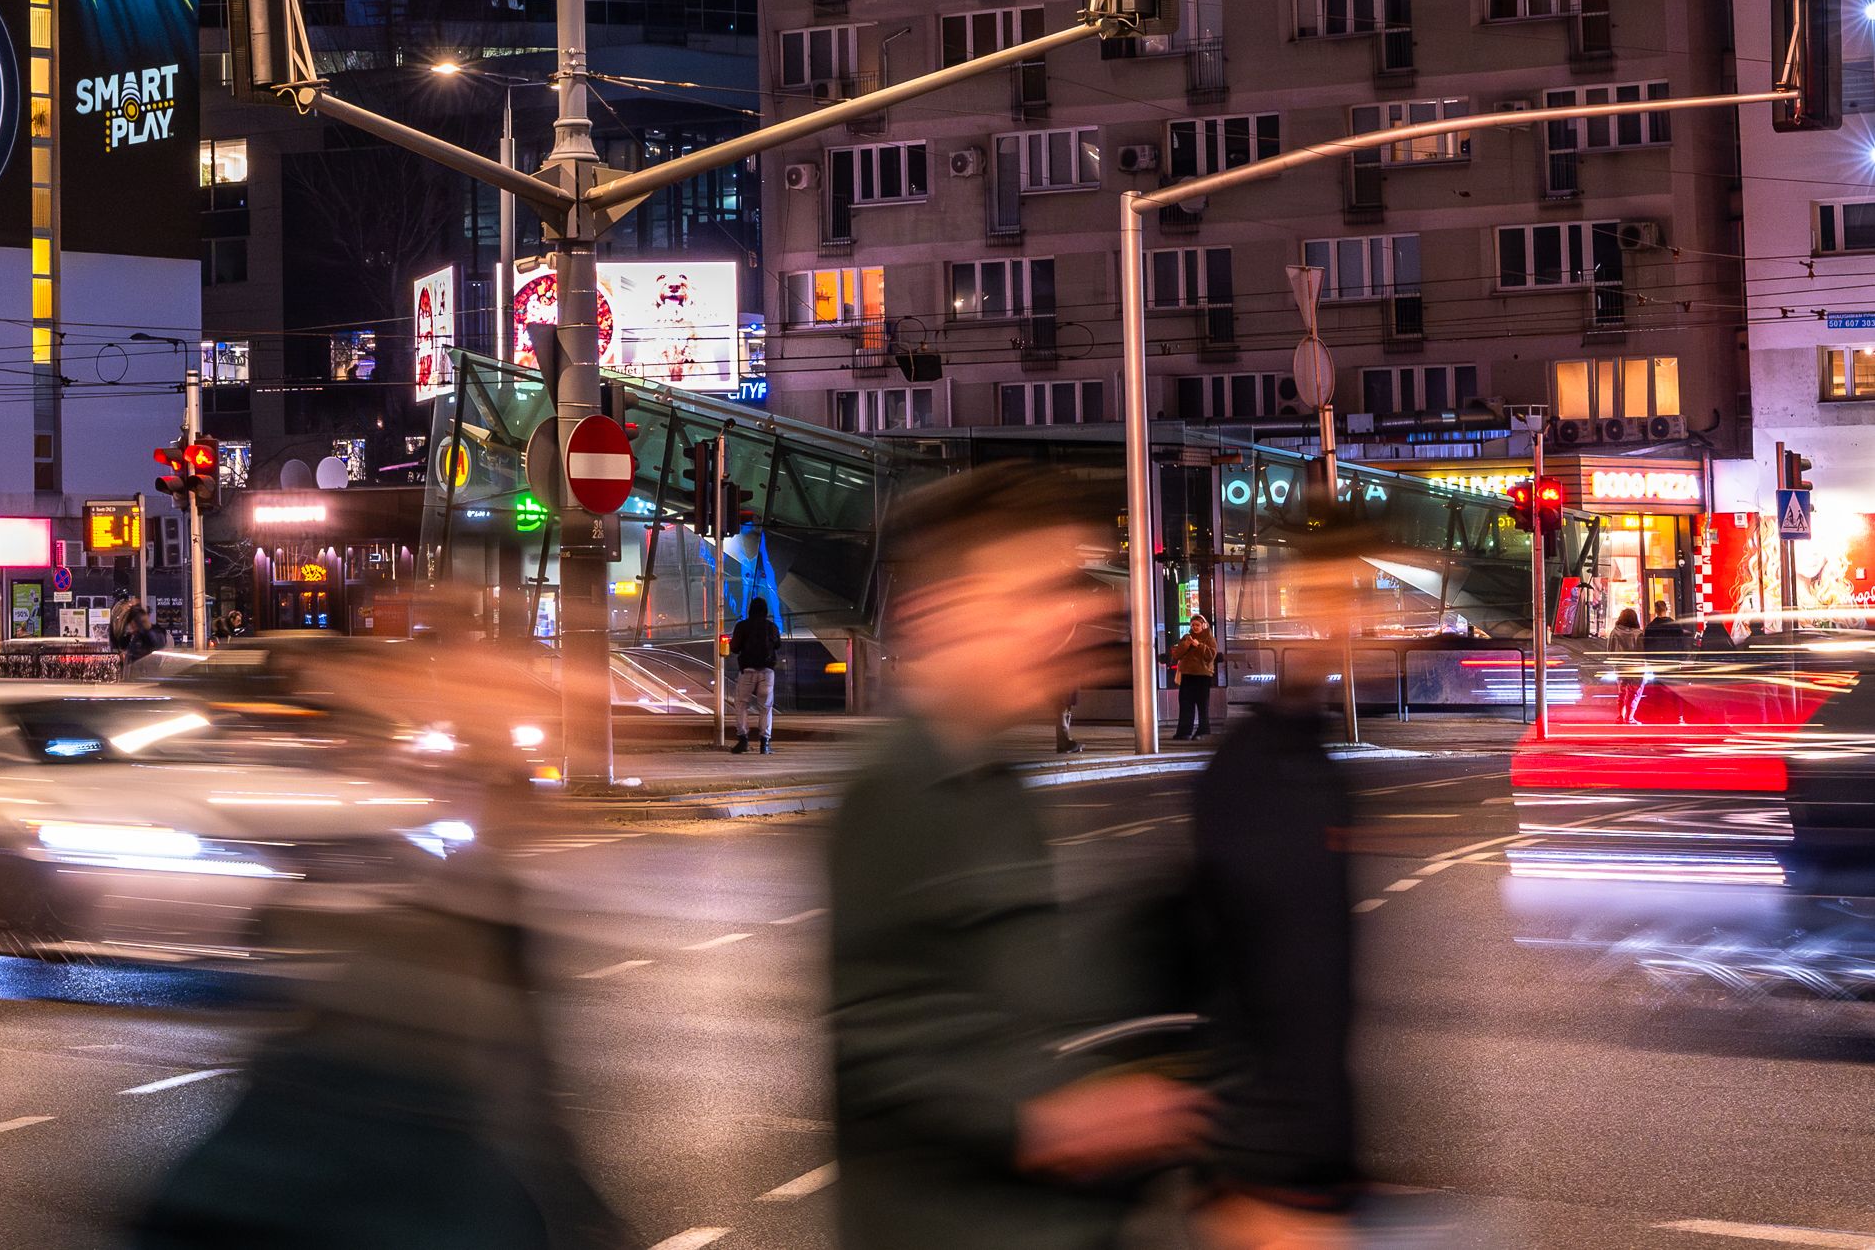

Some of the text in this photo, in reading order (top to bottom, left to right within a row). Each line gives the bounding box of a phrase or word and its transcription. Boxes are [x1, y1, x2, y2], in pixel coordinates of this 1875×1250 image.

[76, 64, 178, 114] SMART
[112, 108, 173, 148] PLAY
[1593, 471, 1646, 499] DODO
